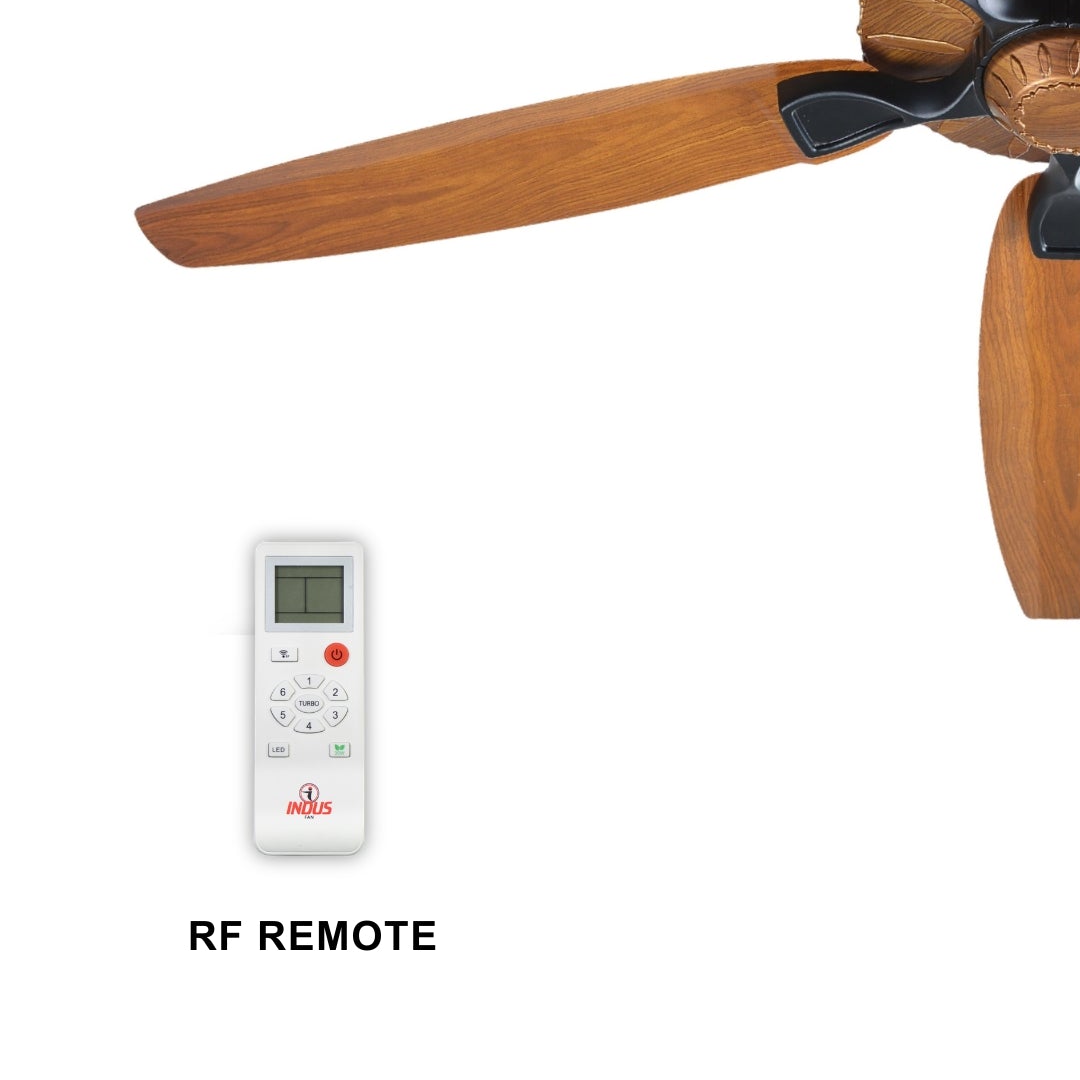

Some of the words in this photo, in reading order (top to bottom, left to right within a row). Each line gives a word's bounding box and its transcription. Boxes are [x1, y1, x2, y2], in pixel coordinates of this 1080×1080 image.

[307, 676, 312, 685] 1
[280, 688, 286, 697] 6
[332, 688, 339, 697] 2
[280, 710, 286, 719] 5
[332, 710, 339, 719] 3
[306, 721, 312, 730] 4
[286, 801, 333, 815] INDUS
